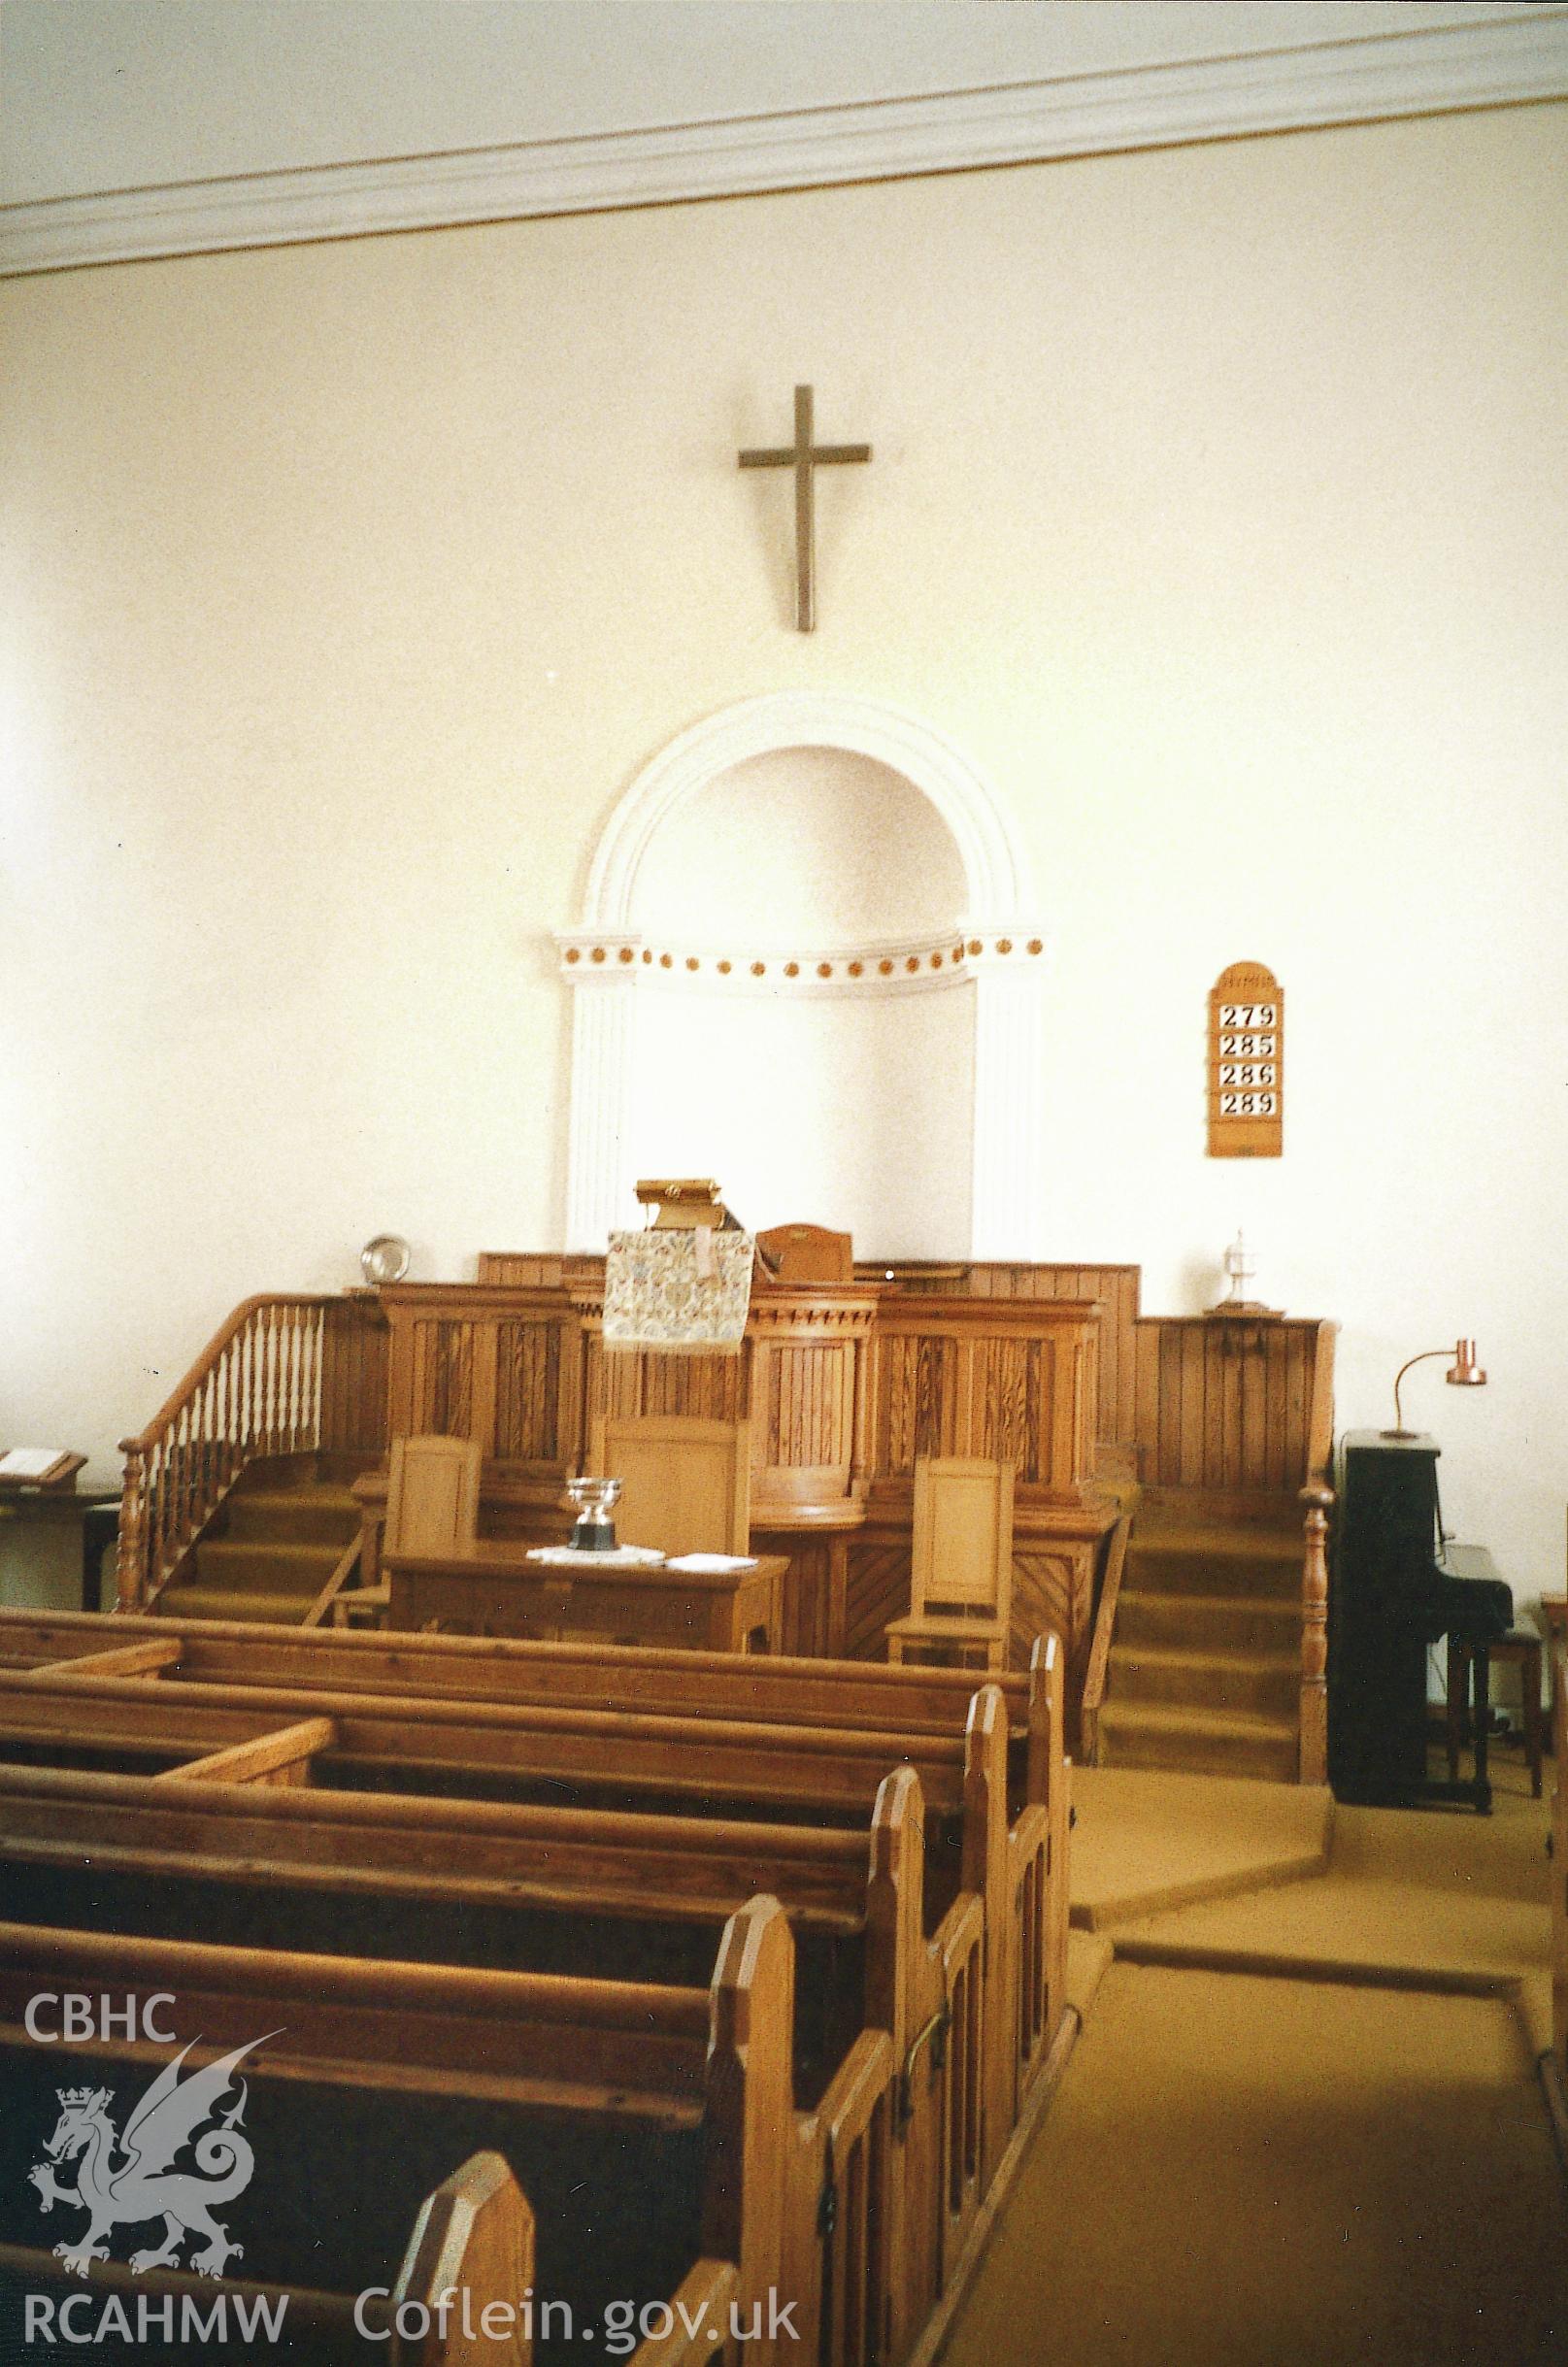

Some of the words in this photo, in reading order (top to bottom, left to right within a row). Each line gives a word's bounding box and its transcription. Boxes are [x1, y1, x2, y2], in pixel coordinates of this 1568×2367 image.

[1223, 1006, 1273, 1027] 279
[1223, 1035, 1272, 1056] 285
[1223, 1064, 1272, 1085] 286
[1224, 1093, 1272, 1114] 289
